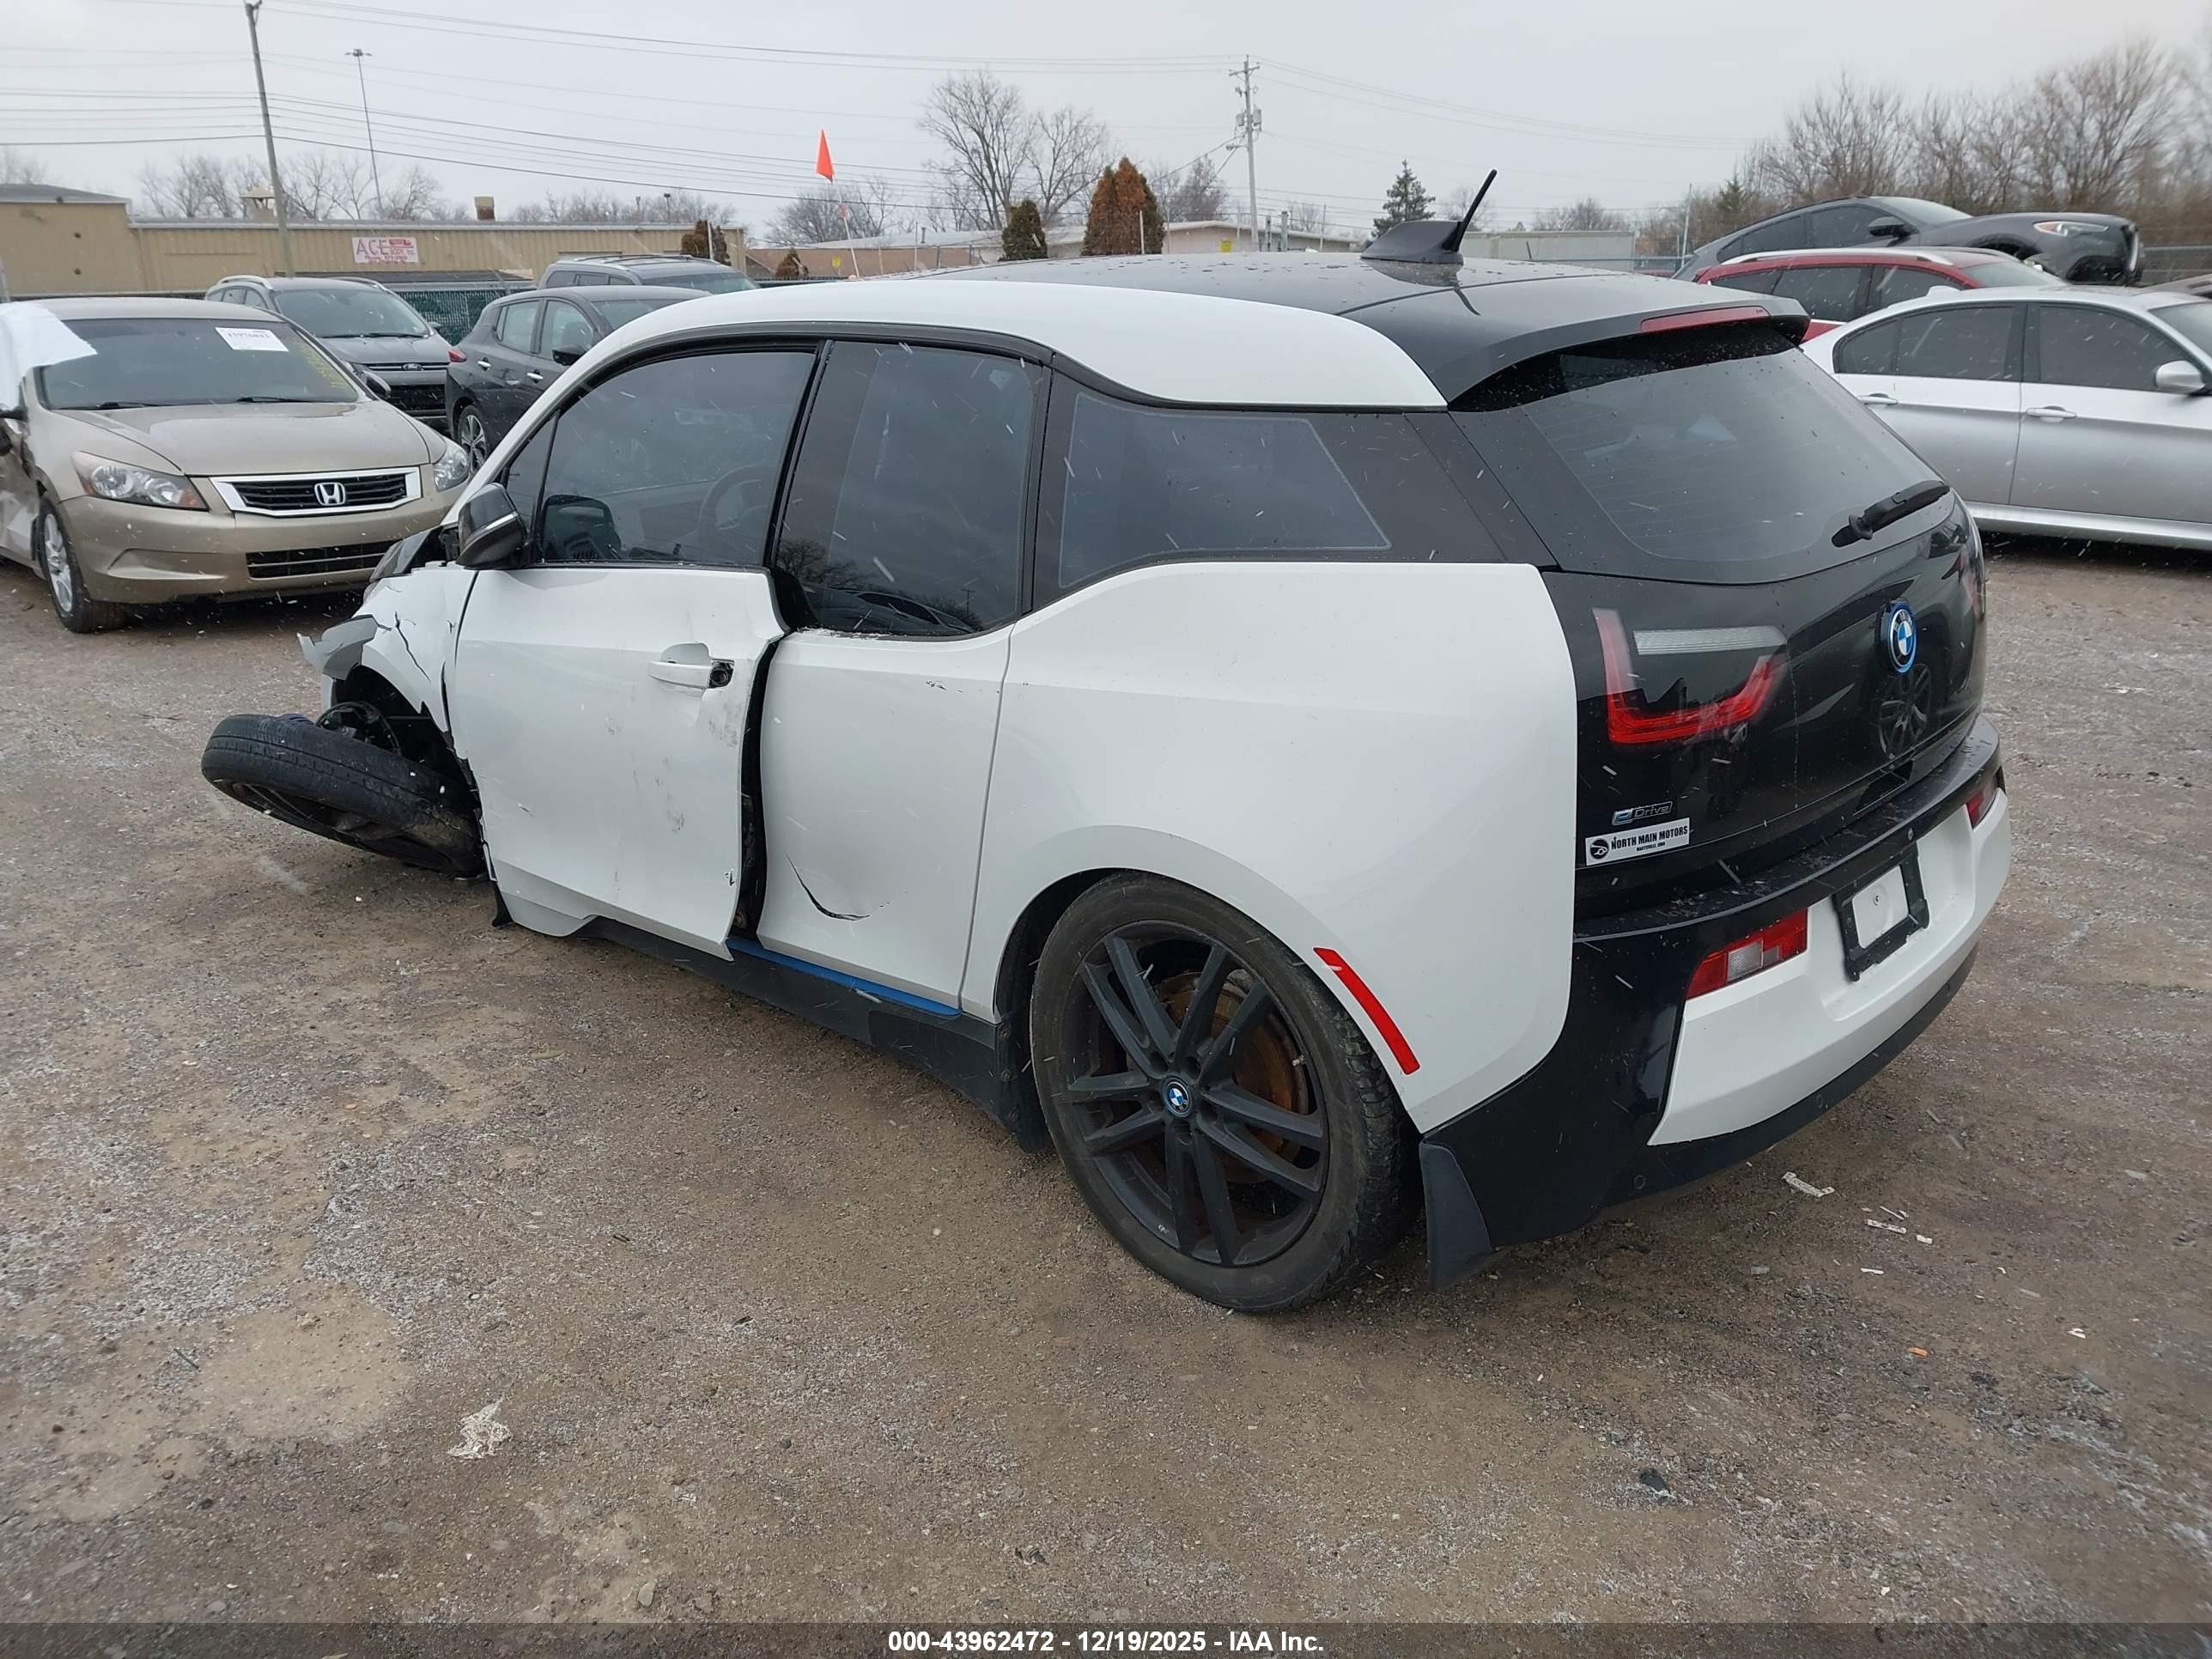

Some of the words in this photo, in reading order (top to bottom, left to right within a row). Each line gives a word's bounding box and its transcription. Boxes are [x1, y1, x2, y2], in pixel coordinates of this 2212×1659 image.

[356, 239, 389, 255] ACE
[1611, 836, 1637, 850] NORTH
[1638, 832, 1657, 845] MAIN
[1659, 825, 1688, 841] MOTORS
